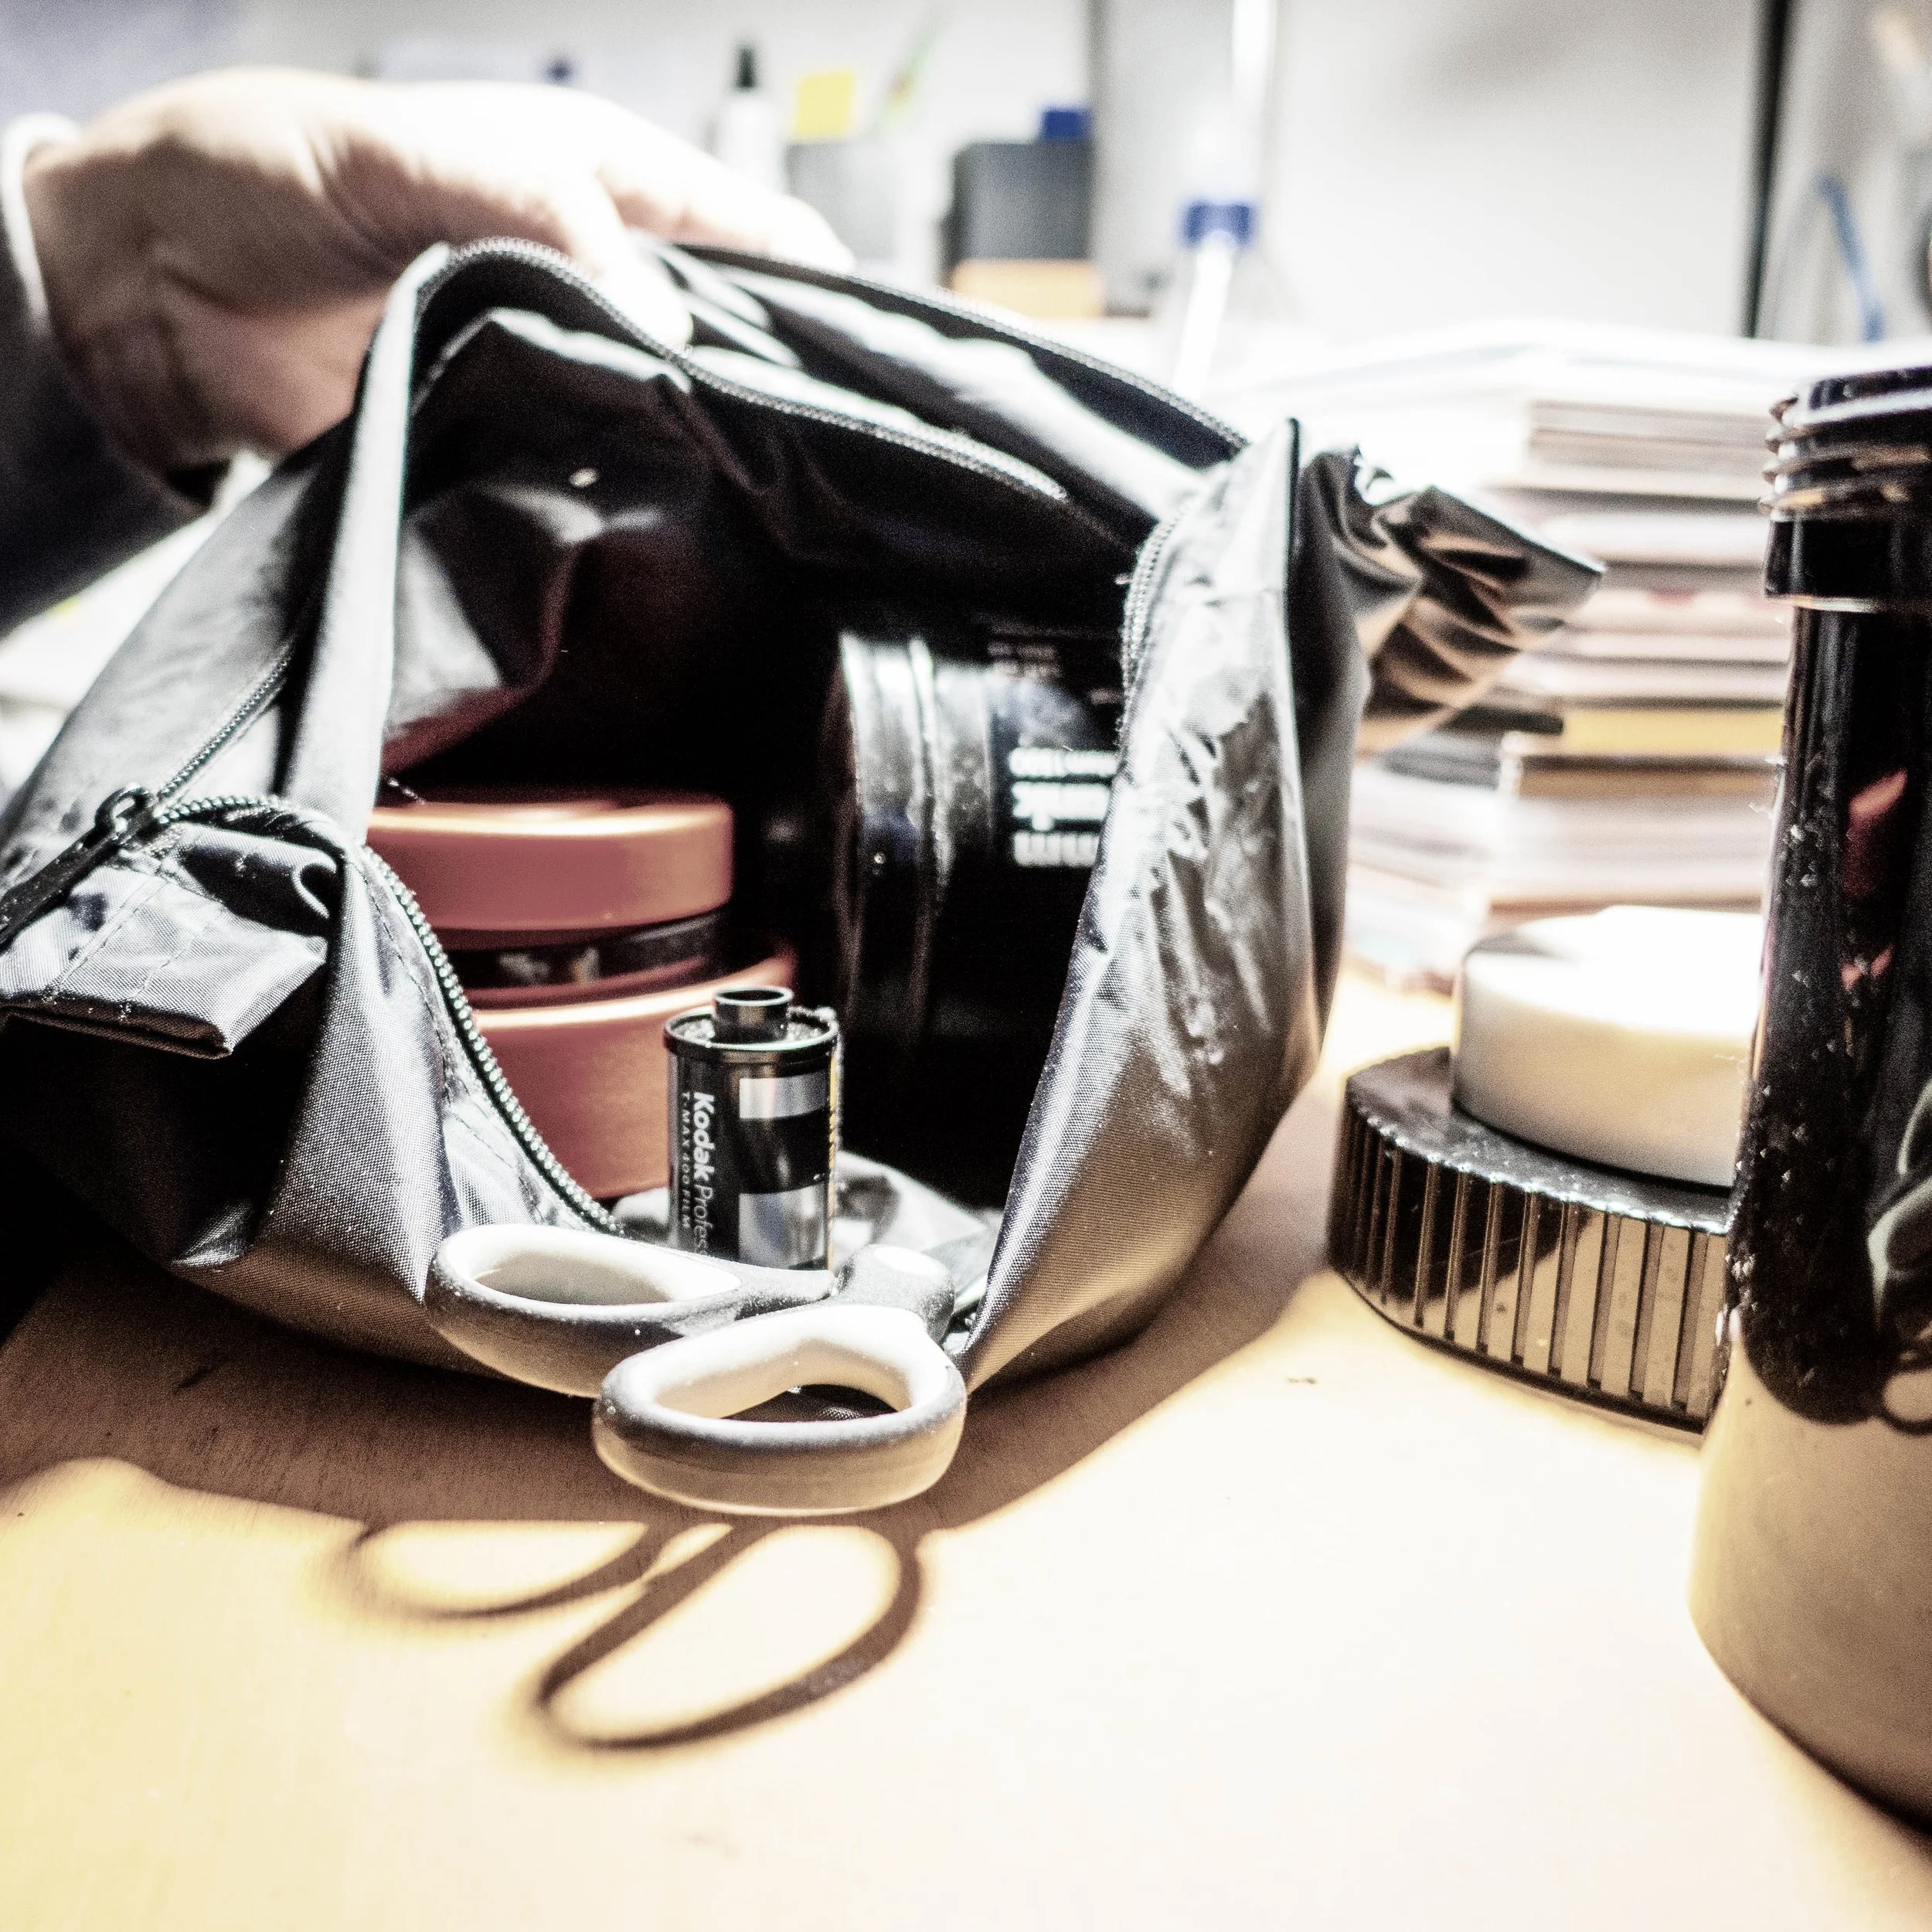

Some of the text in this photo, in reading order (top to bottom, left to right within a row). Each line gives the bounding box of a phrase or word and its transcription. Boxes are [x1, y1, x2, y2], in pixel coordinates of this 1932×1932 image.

[682, 1091, 691, 1229] T-MAX 400 FILM
[693, 1091, 716, 1181] Kodak
